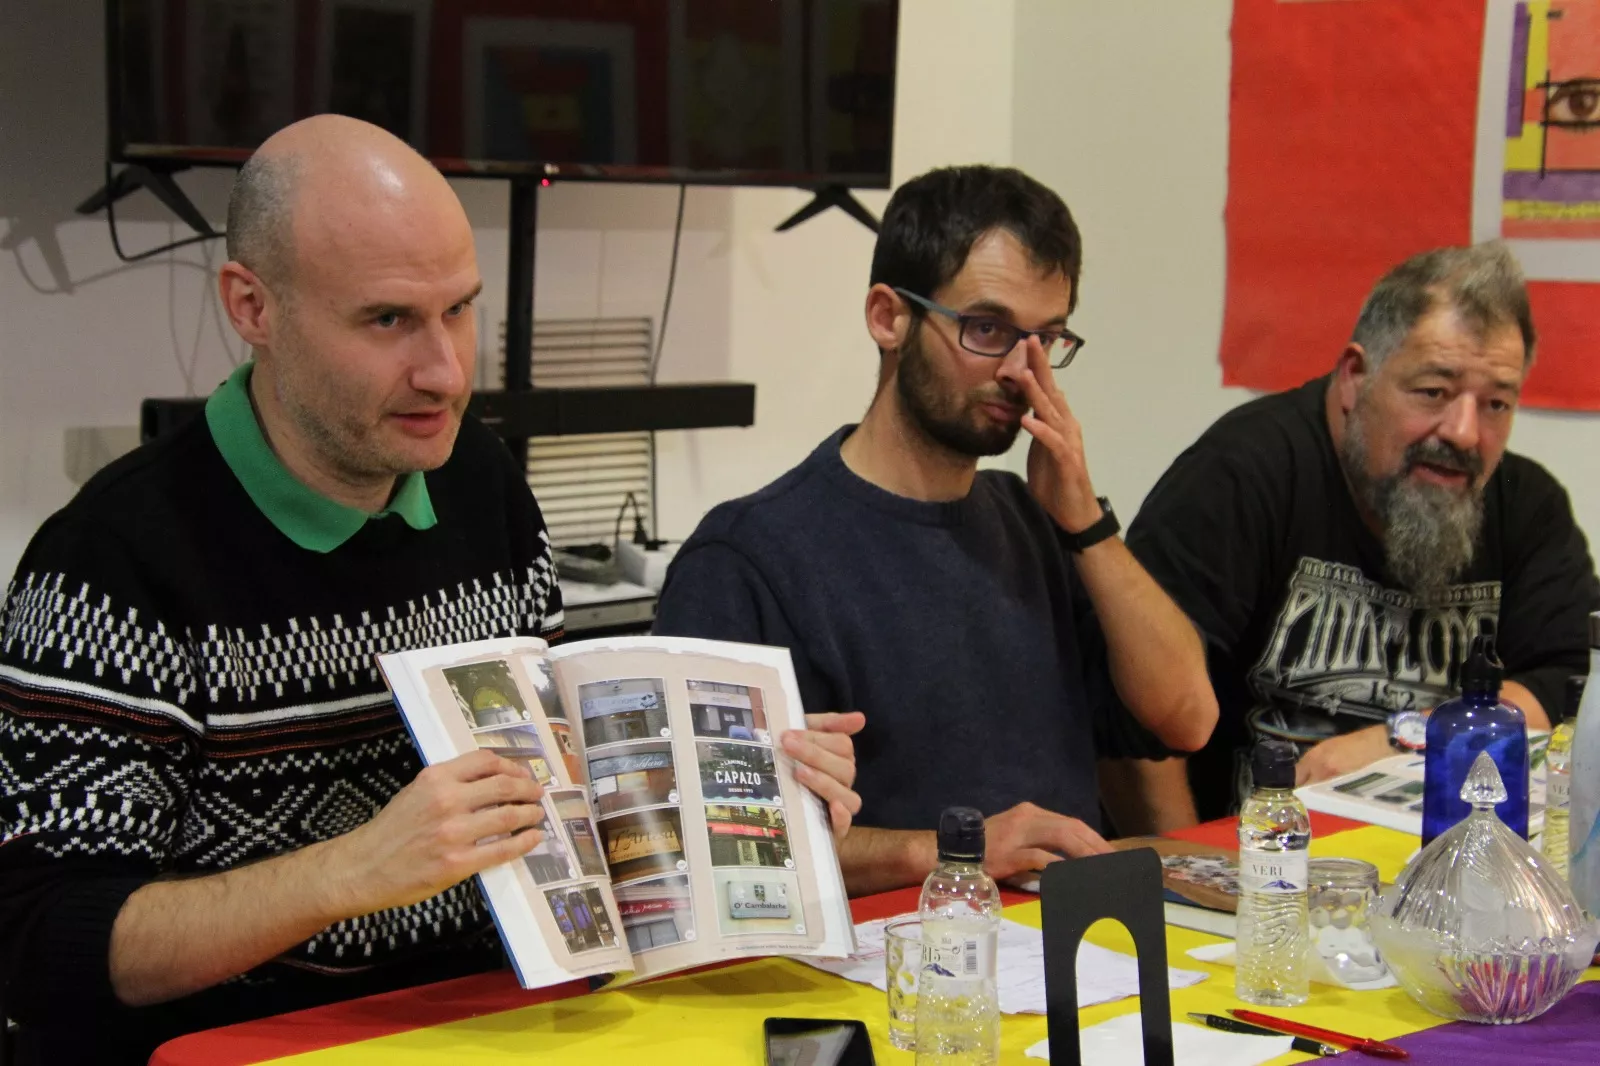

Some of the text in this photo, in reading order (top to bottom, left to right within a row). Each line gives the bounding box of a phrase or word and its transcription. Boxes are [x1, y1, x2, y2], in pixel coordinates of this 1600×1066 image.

[715, 770, 762, 786] CAPAZO
[1252, 863, 1283, 877] VERI
[744, 902, 787, 910] Cambalache
